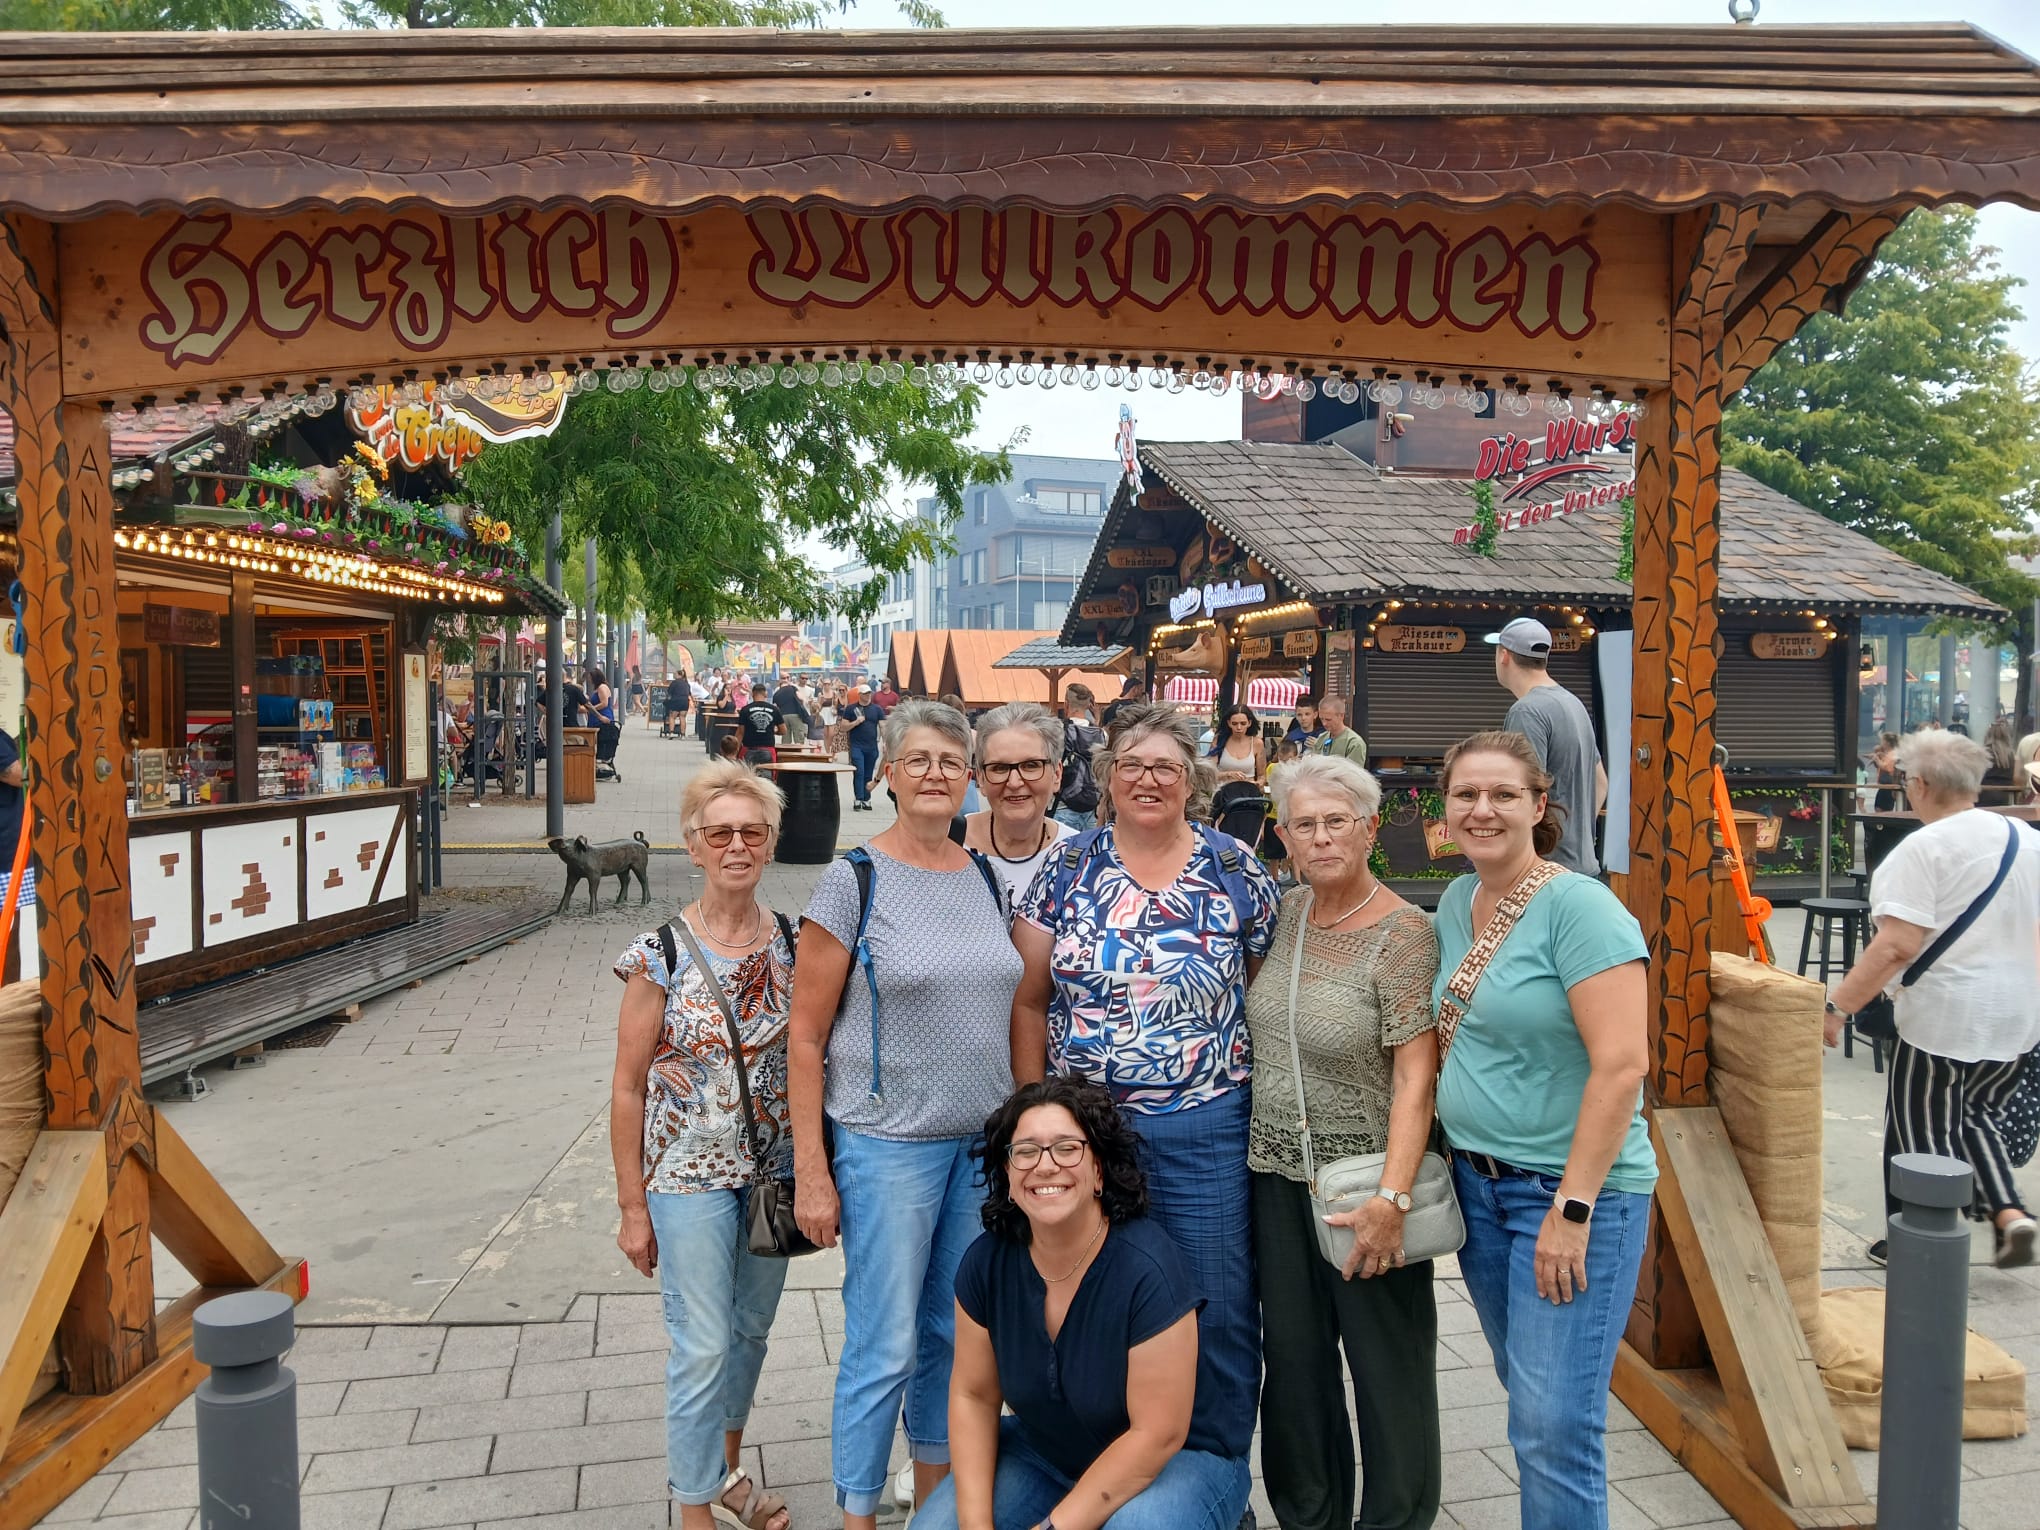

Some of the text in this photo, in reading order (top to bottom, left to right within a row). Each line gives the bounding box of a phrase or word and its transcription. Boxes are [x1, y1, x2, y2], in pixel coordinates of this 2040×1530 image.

[139, 206, 1599, 370] Herzlich Willkommen
[396, 405, 483, 469] Crêpe
[1474, 432, 1531, 480] Die
[1453, 510, 1512, 545] maht
[1520, 501, 1553, 527] den
[1400, 627, 1444, 639] Riesen
